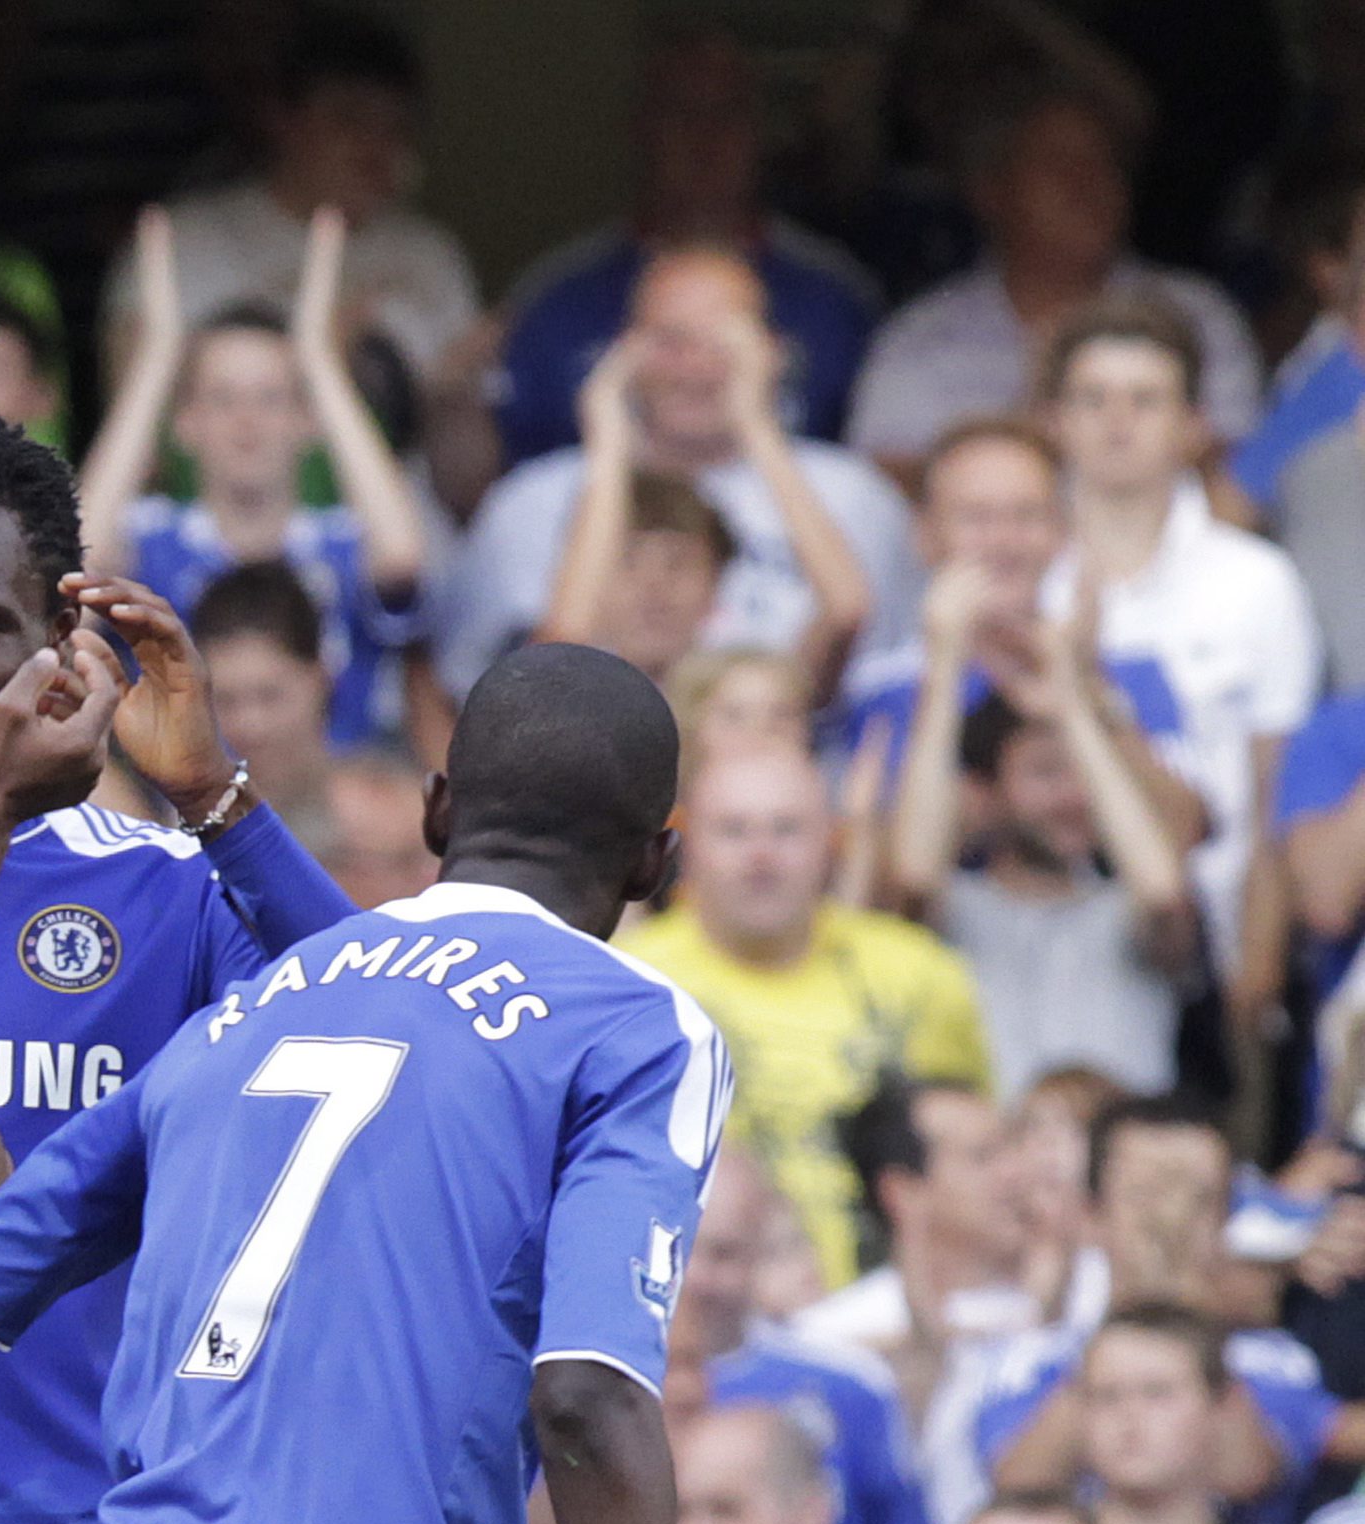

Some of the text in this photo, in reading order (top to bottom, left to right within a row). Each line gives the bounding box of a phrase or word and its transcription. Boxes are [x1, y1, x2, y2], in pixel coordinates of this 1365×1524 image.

[37, 910, 99, 930] CHELSEA
[207, 934, 550, 1044] RAMIRES
[174, 1036, 410, 1382] 7
